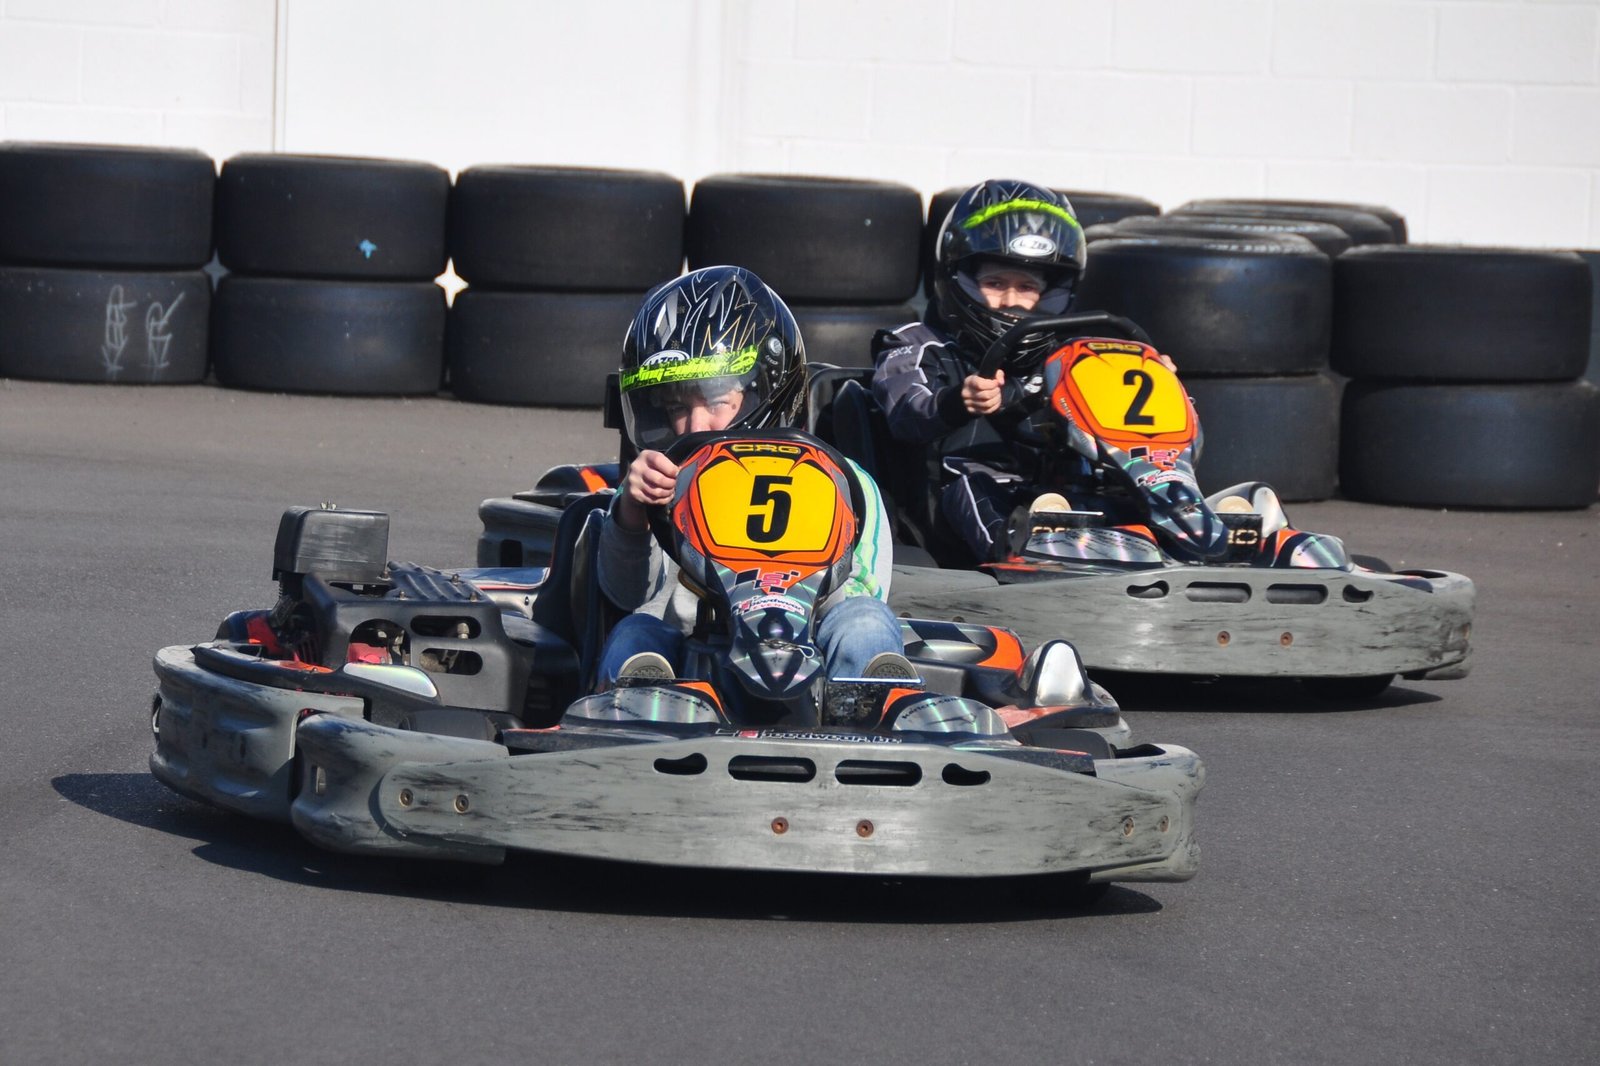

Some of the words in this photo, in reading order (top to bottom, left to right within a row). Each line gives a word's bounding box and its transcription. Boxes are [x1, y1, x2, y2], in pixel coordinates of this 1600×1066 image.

[1122, 369, 1156, 426] 2
[731, 443, 802, 455] CRG
[745, 474, 794, 544] 5
